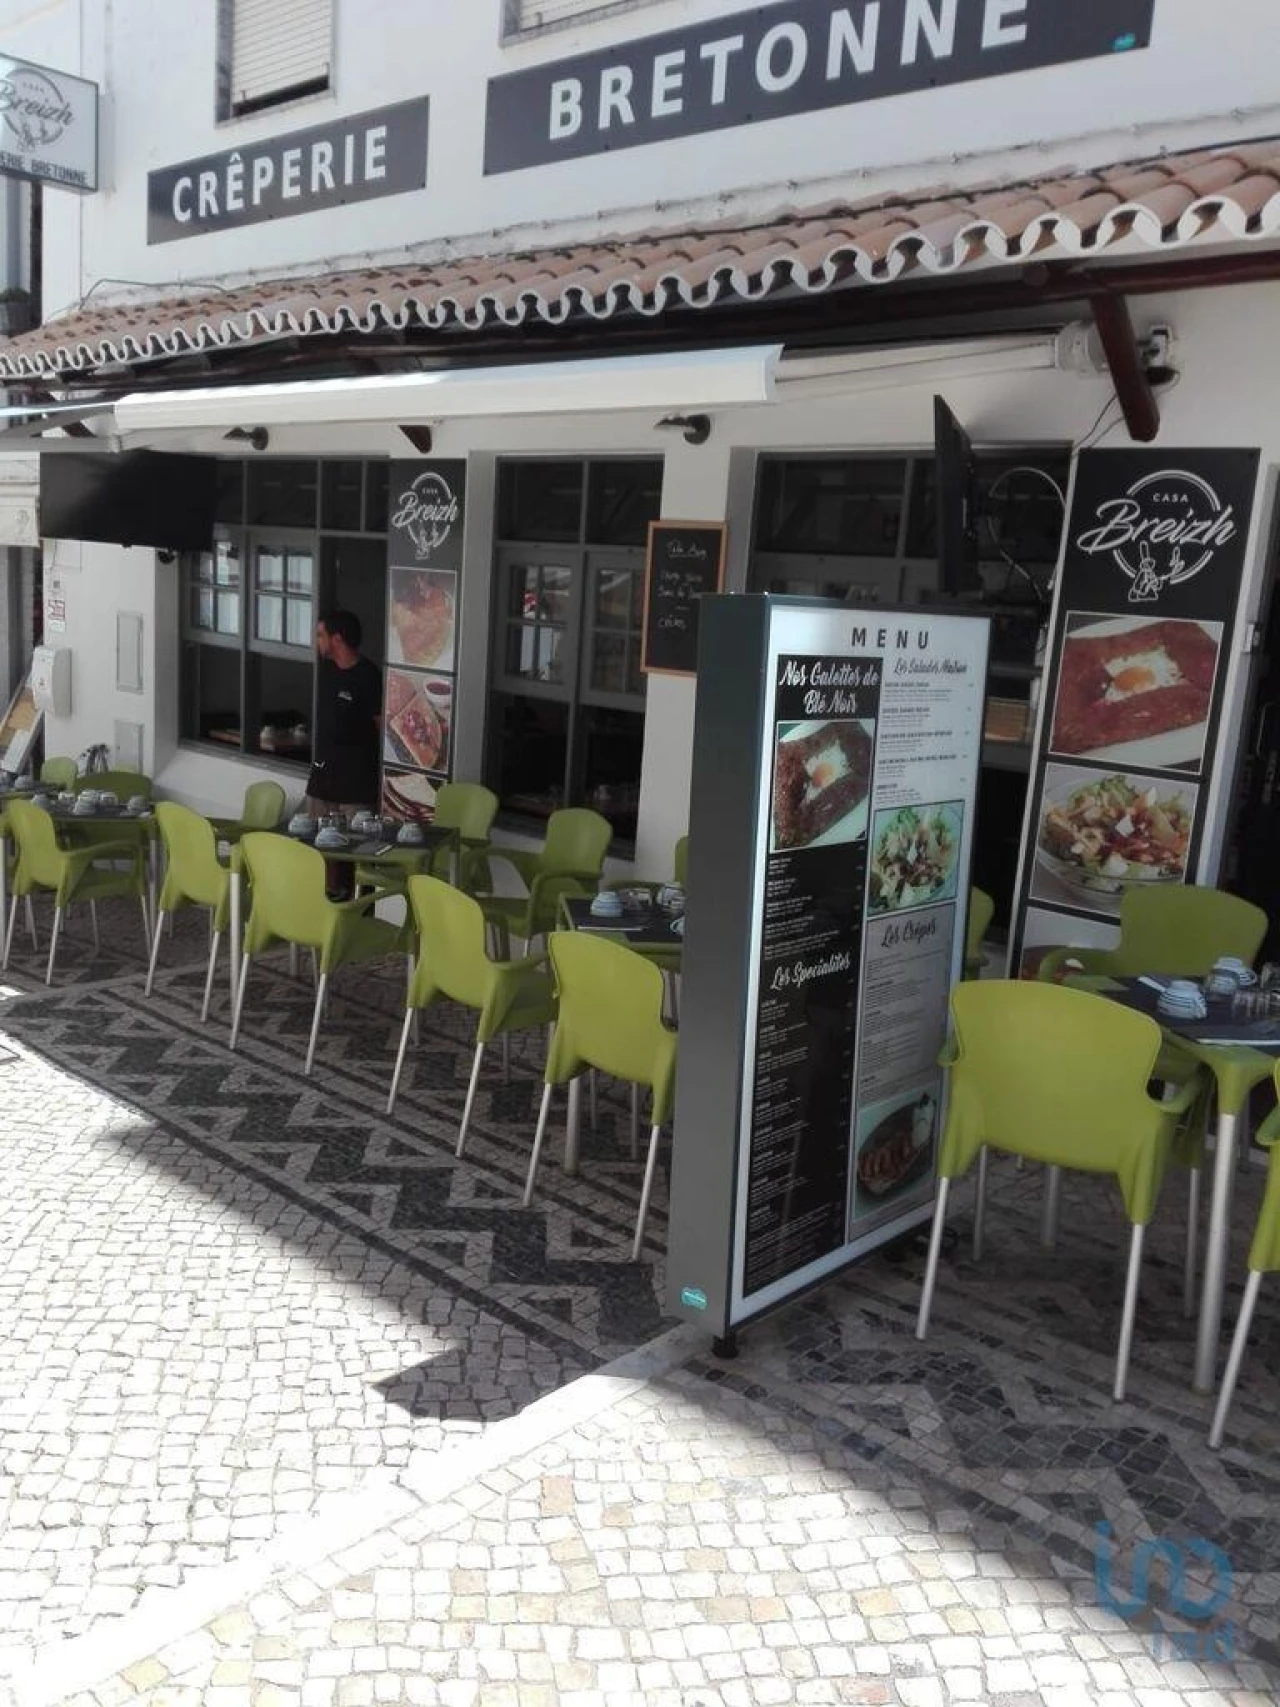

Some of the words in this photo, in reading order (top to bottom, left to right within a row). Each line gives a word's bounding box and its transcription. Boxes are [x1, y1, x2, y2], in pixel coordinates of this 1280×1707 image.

[548, 0, 1028, 141] BRETONNE
[172, 125, 388, 223] CRÊPERIE
[391, 491, 458, 528] Breizh
[1152, 493, 1189, 503] CASA
[1077, 499, 1238, 554] Breizh
[851, 627, 930, 649] MENU
[778, 660, 807, 686] Nos
[809, 661, 860, 687] Galettes
[862, 664, 879, 686] de
[882, 924, 900, 948] Les
[770, 966, 791, 990] Les
